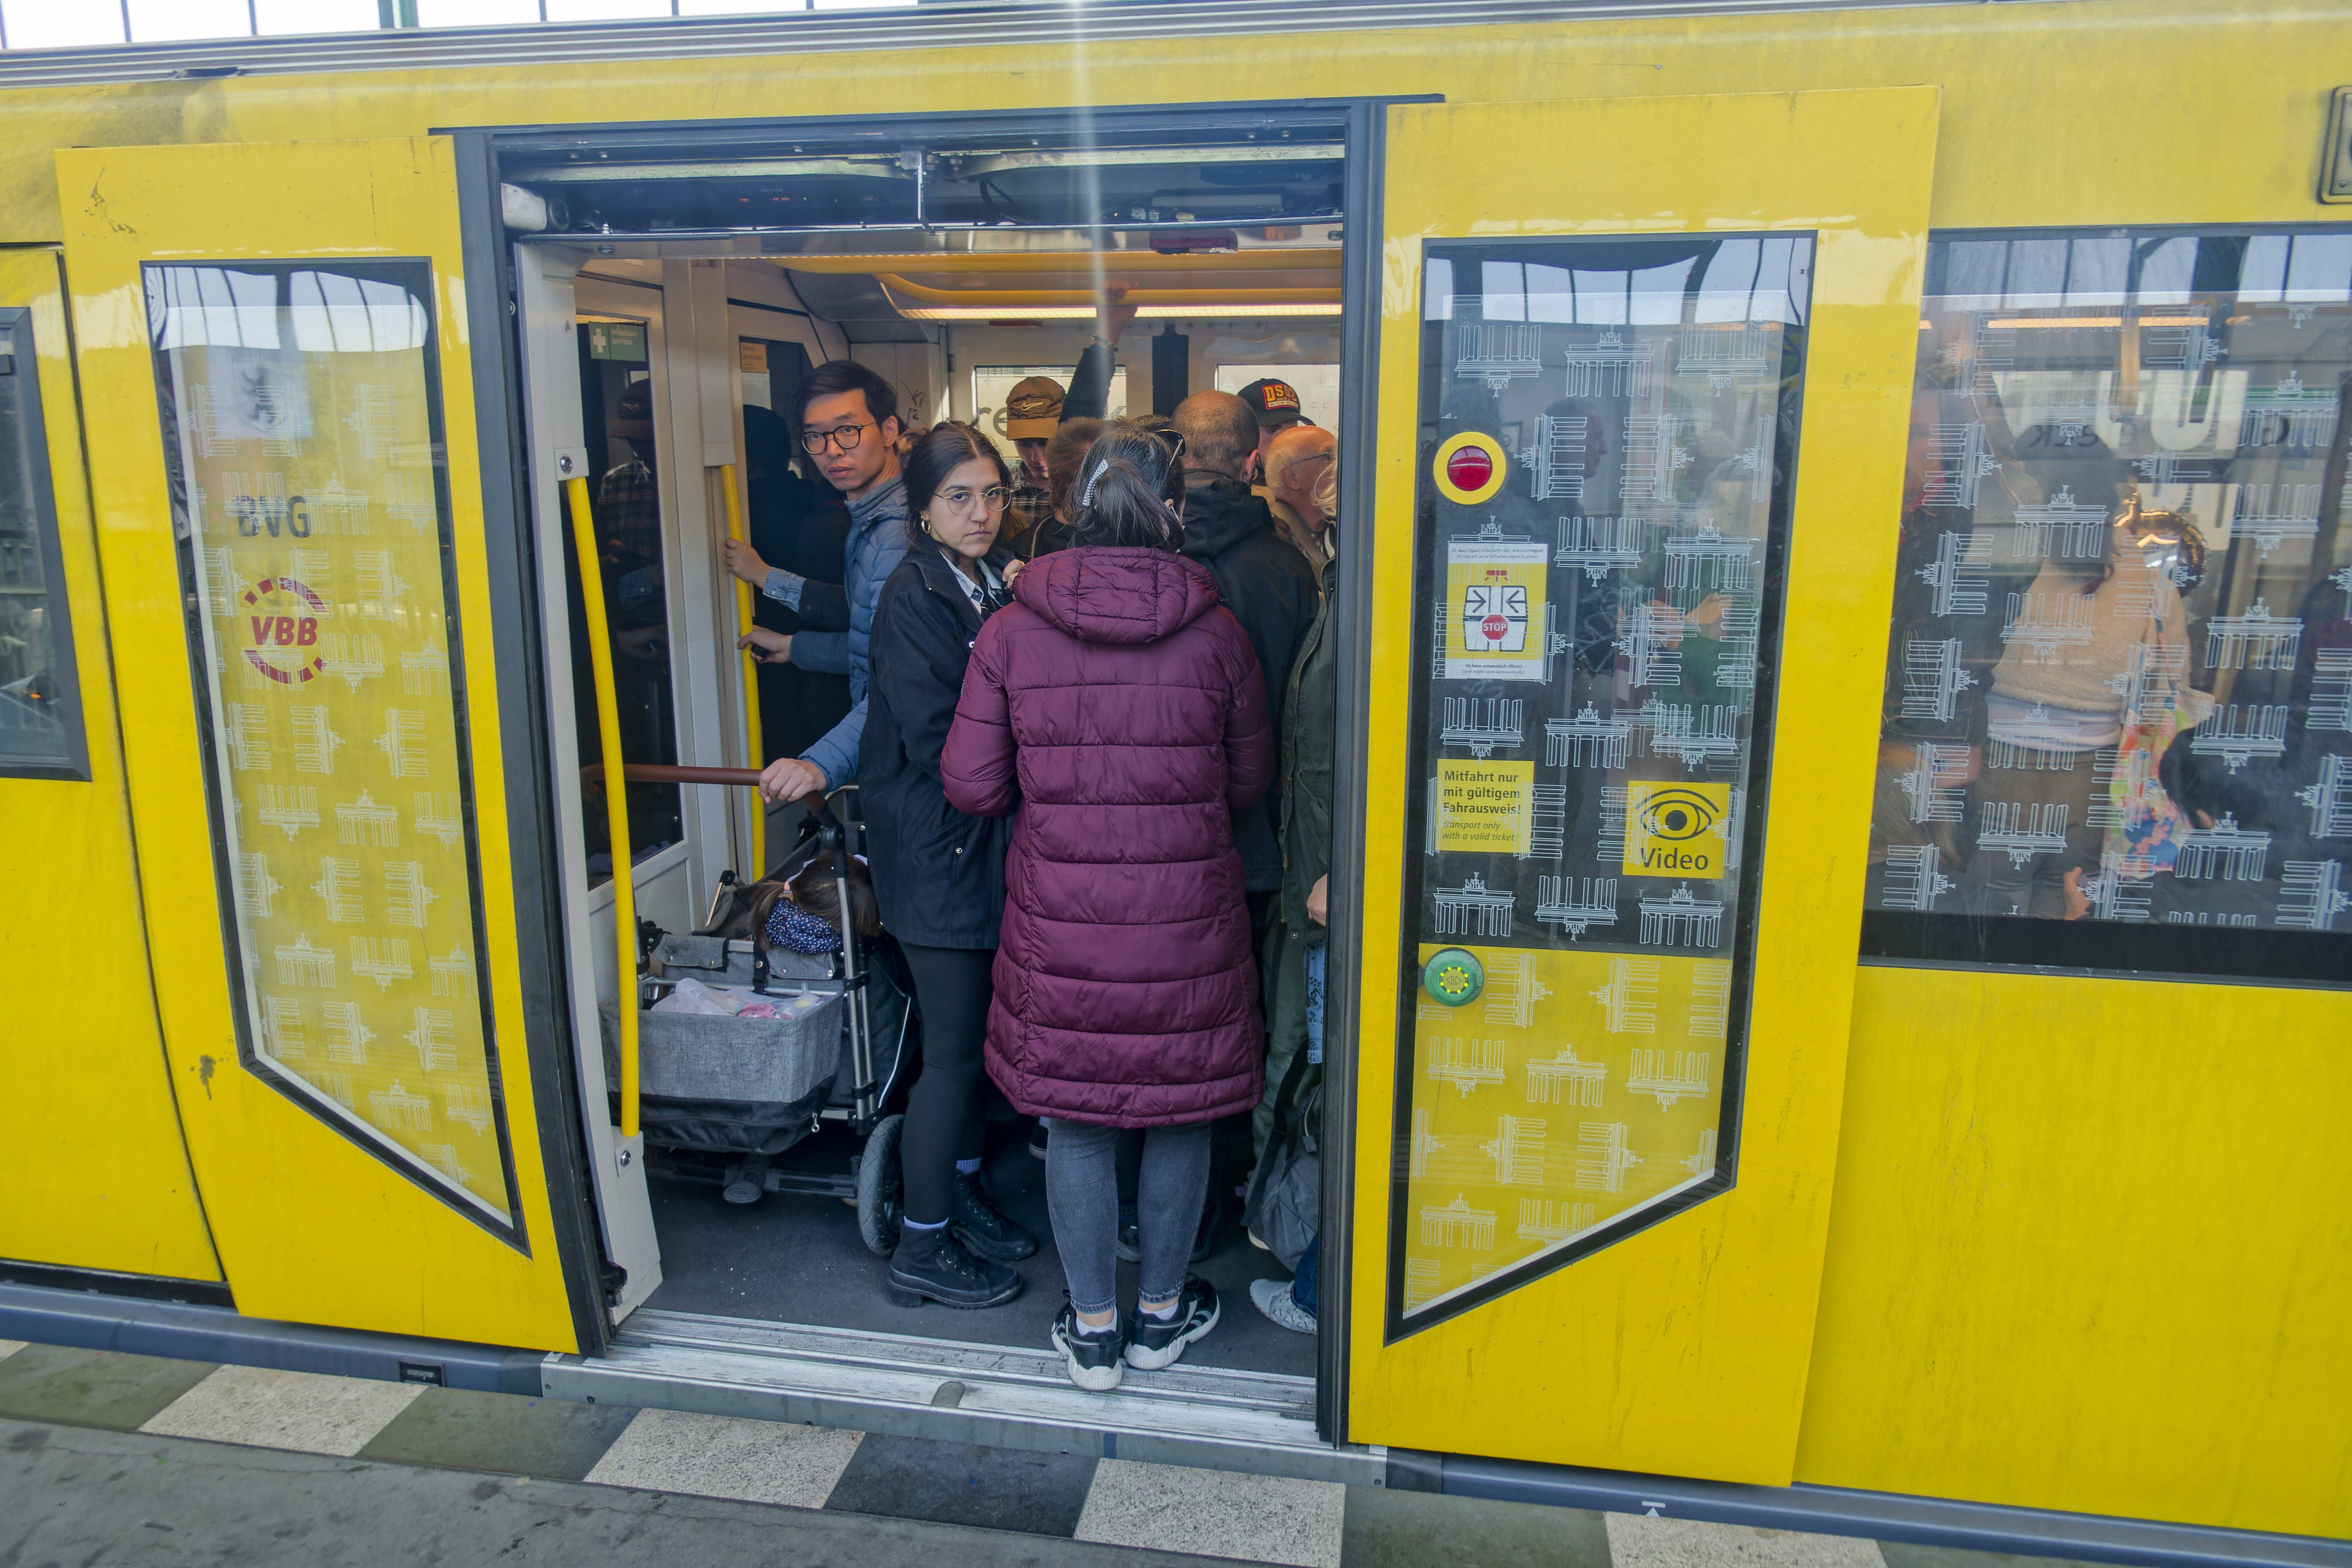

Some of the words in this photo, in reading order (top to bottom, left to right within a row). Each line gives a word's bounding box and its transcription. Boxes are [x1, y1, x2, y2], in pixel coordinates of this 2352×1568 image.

[236, 496, 311, 538] BVG
[251, 616, 317, 646] VBB
[1445, 771, 1494, 782] Mitfahrt
[1444, 787, 1463, 797] mit
[1467, 787, 1520, 800] gültigem
[1443, 802, 1521, 814] Fahrausweis!
[1483, 821, 1501, 831] only
[1641, 848, 1709, 870] Video
